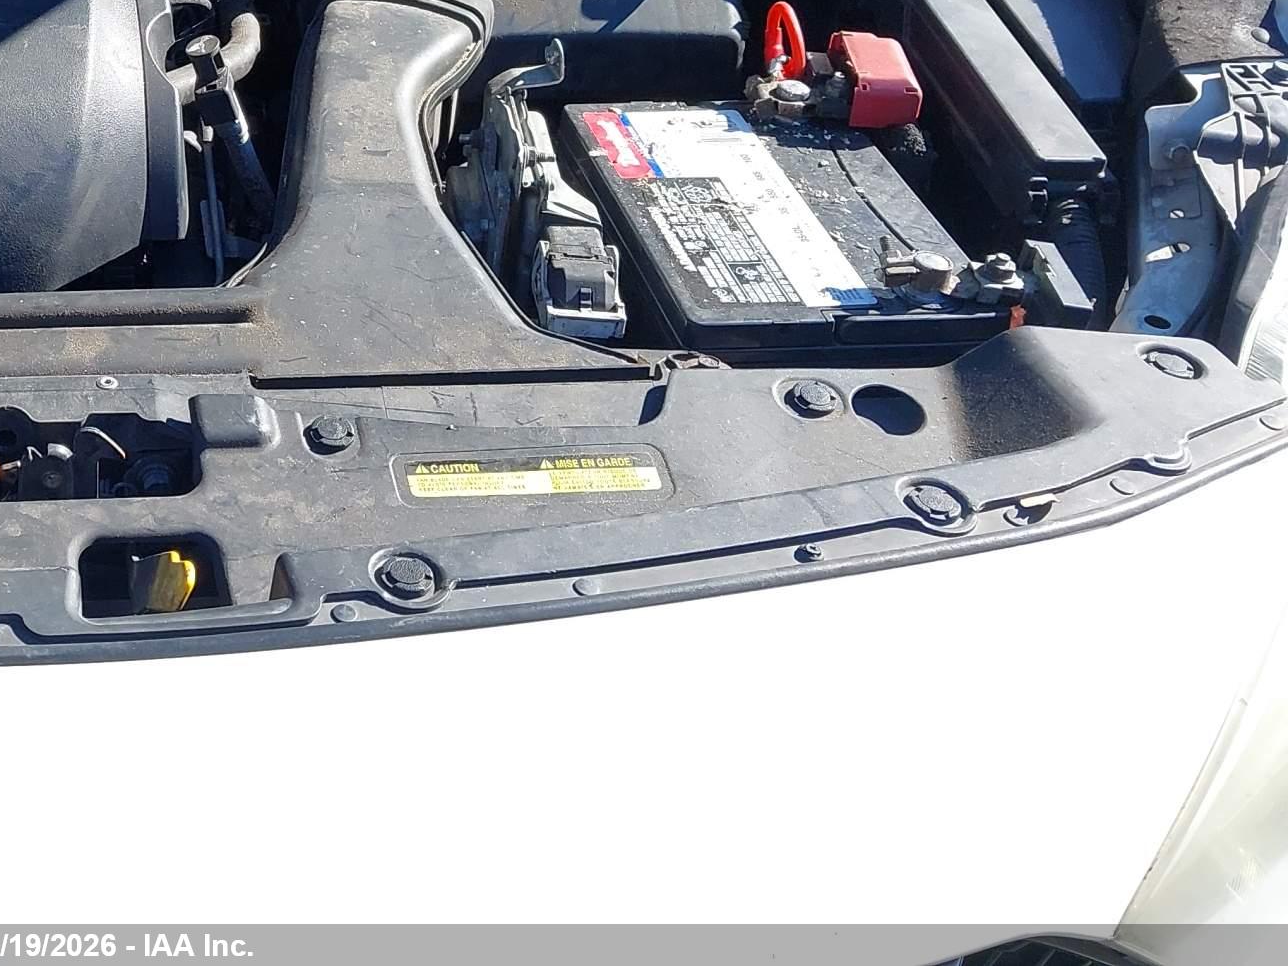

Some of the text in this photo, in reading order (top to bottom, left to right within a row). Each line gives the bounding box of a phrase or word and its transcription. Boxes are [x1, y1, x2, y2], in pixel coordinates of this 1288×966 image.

[430, 463, 480, 474] CAUTION
[555, 457, 633, 469] MISE EN GARDE
